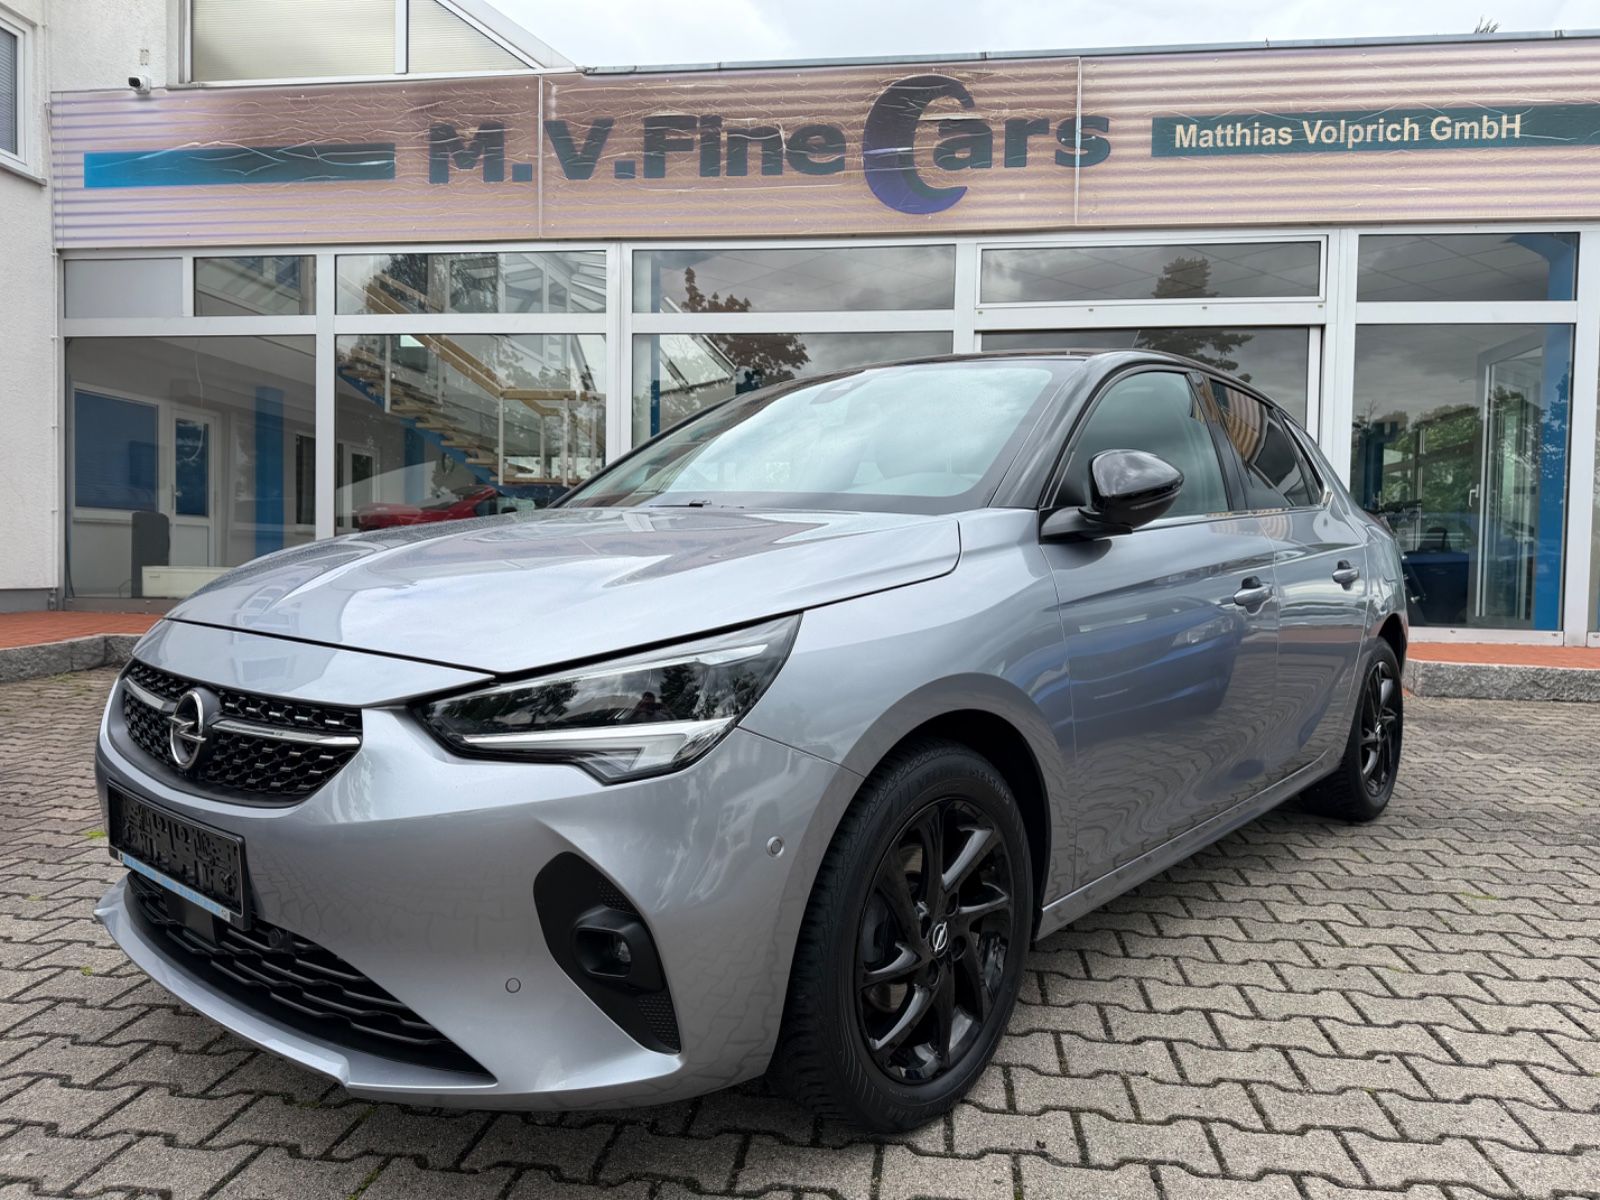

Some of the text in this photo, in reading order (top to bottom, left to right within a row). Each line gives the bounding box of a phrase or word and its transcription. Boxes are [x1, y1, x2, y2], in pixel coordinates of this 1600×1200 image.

[863, 74, 1111, 214] Cars
[1174, 114, 1522, 149] Matthias Volprich GmbH
